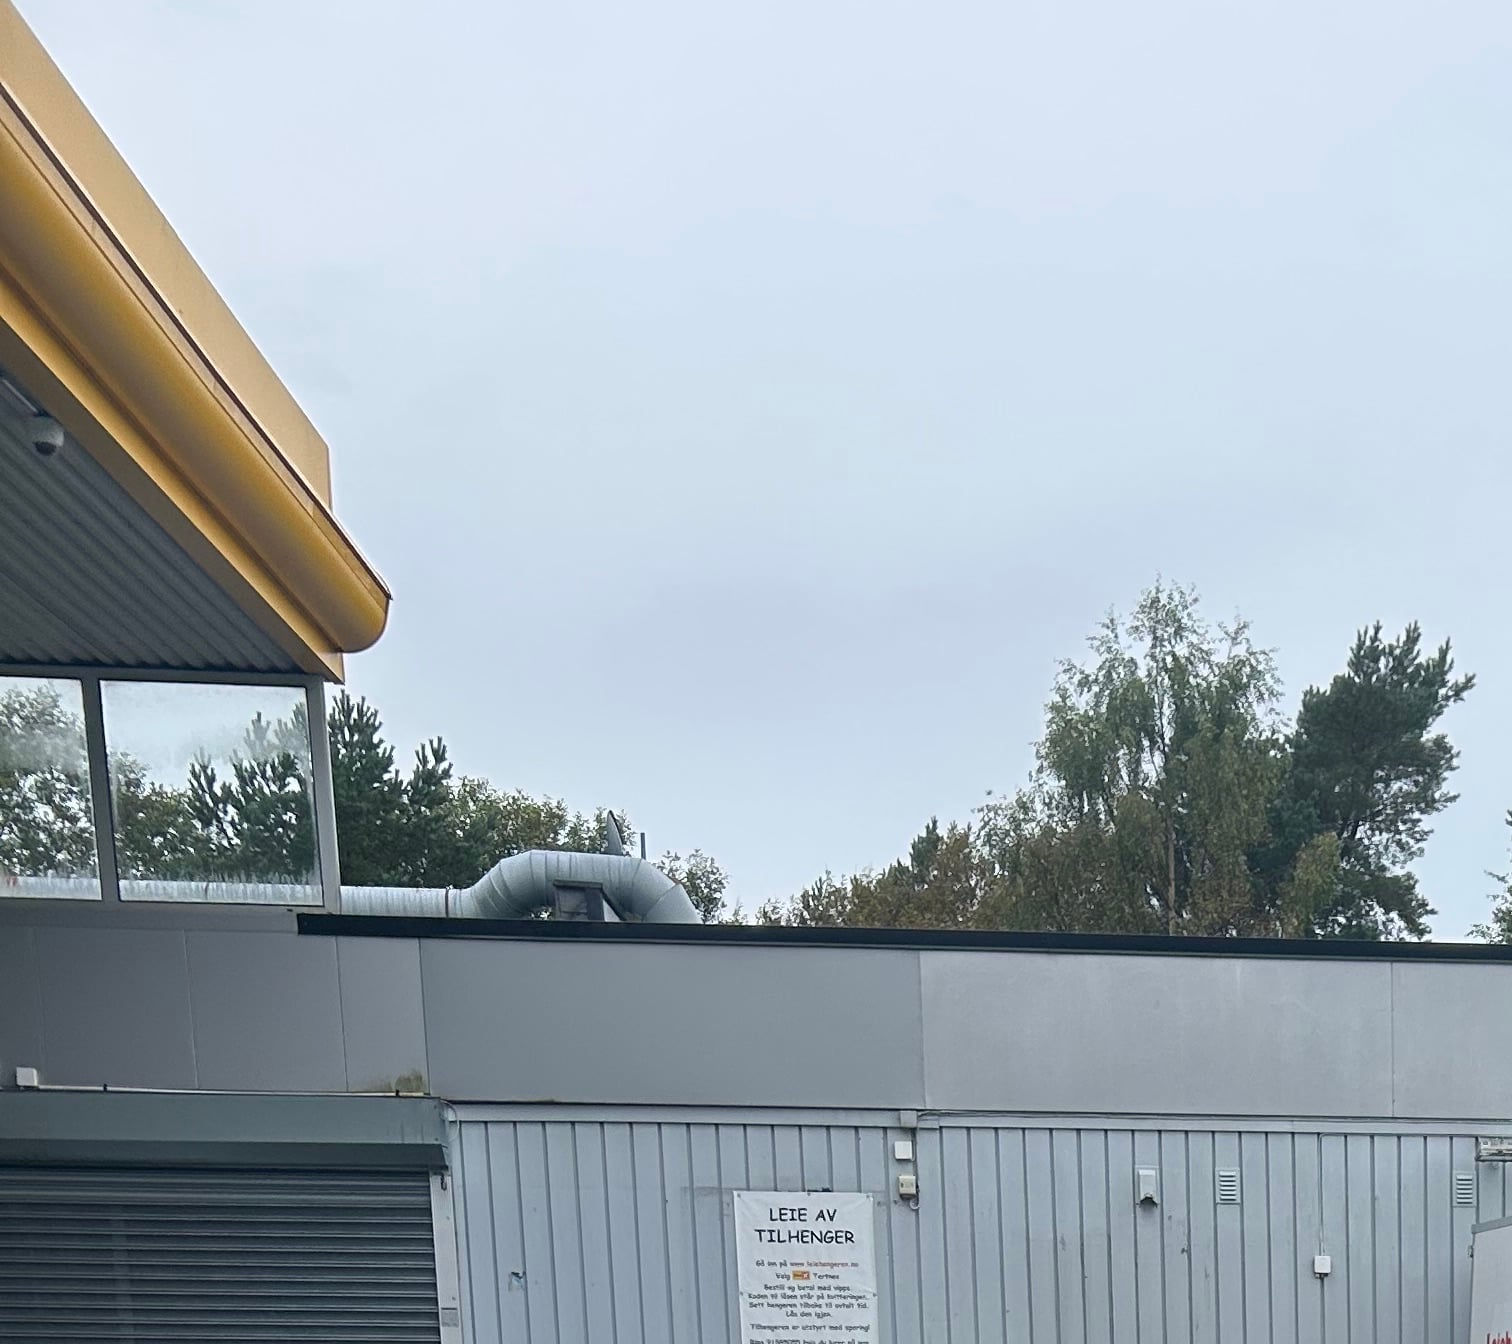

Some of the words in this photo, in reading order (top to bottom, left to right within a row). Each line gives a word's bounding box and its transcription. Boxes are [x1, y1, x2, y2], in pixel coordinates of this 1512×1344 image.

[769, 1208, 808, 1222] LEIE
[815, 1208, 838, 1222] AV
[754, 1229, 855, 1244] TILHENGER
